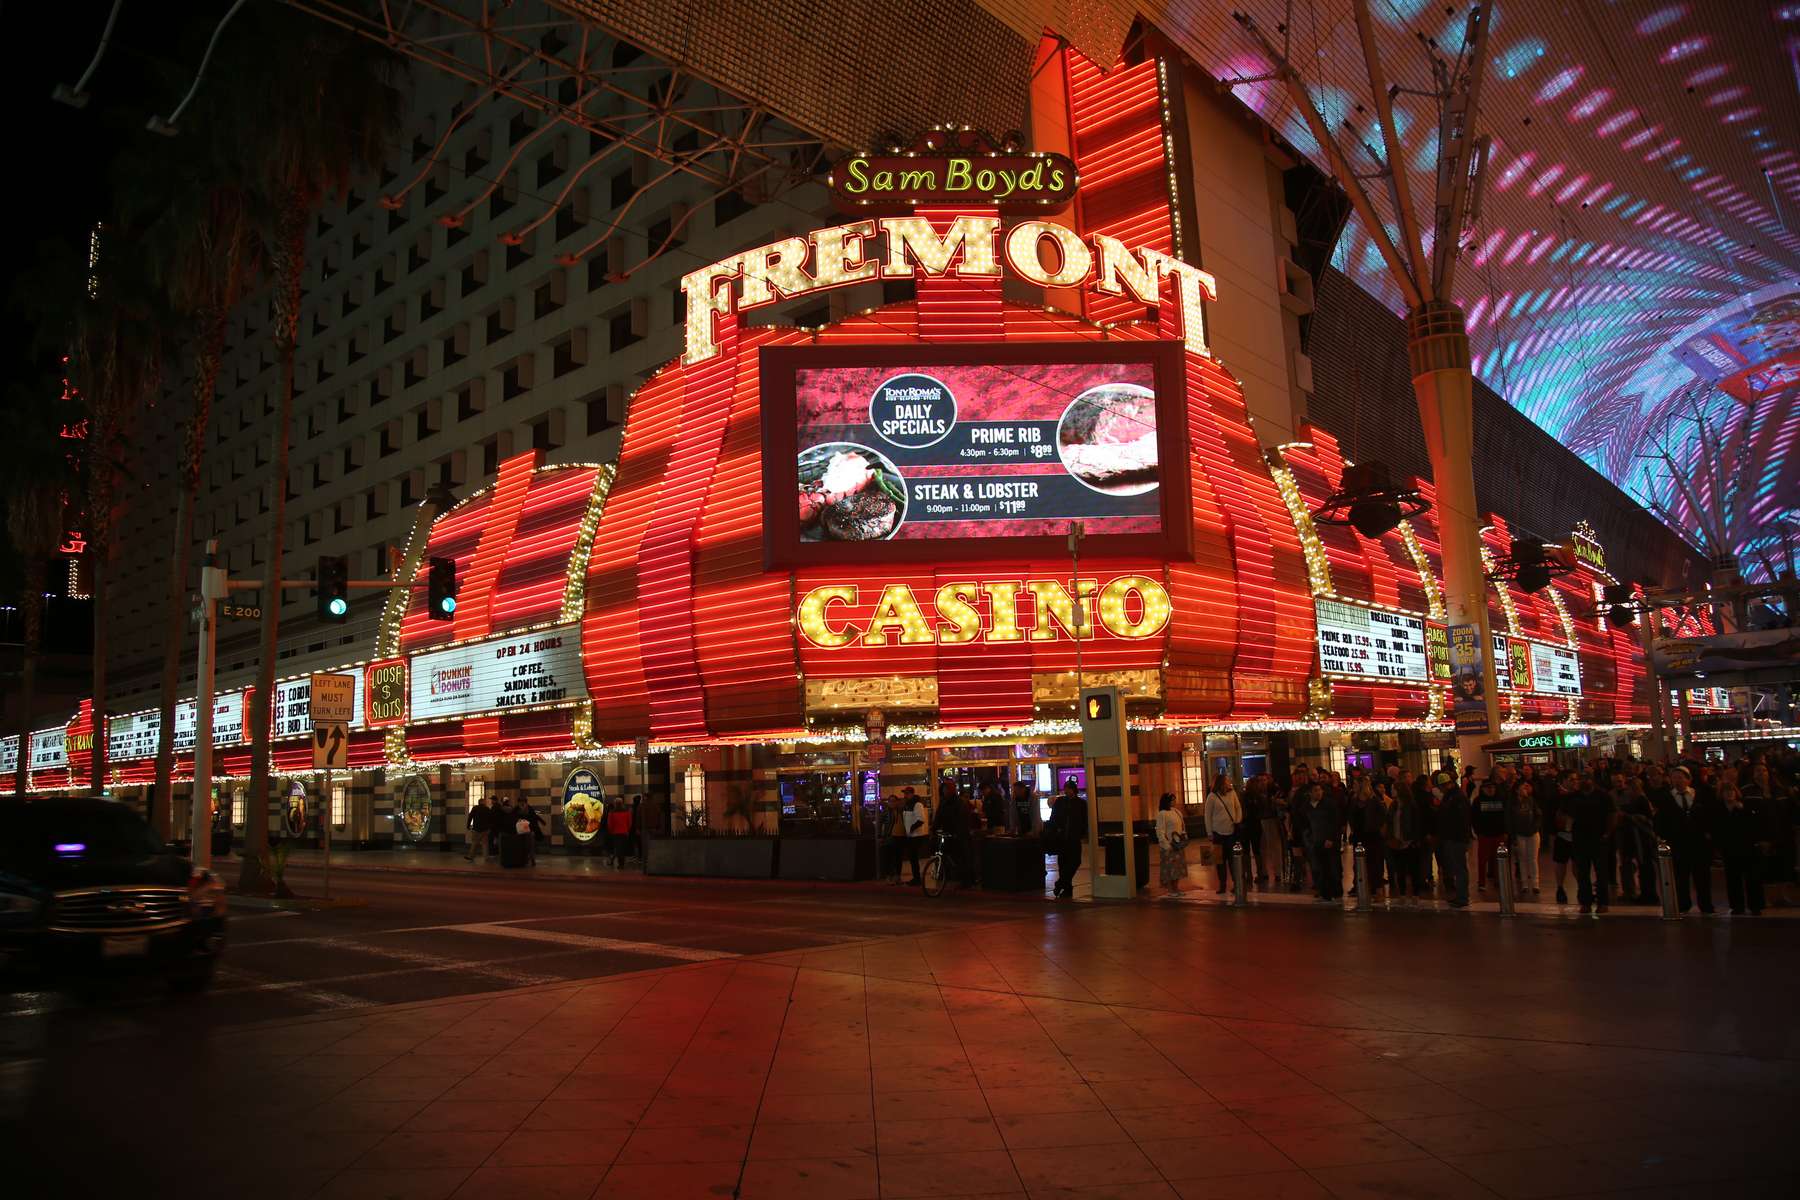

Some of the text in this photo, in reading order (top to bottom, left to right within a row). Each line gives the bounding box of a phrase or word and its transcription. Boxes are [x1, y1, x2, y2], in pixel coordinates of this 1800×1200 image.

[845, 158, 1064, 199] Sam Boyd's
[681, 216, 1217, 369] FREMONT
[884, 388, 908, 396] TONY
[896, 404, 932, 420] DAILY
[882, 419, 946, 435] SPECIALS
[971, 427, 1041, 444] PRIME RIB
[960, 448, 986, 458] 4:30pm
[993, 447, 1020, 458] 6:30pm
[914, 482, 1039, 500] STEAK & LOBSTER
[926, 504, 953, 514] 9:00pm
[961, 503, 991, 513] 11:00pm
[223, 604, 261, 618] E 200
[798, 575, 1172, 649] CASINO
[1322, 630, 1340, 643] PRIME
[1452, 628, 1472, 636] ZOOM
[1453, 634, 1474, 644] UP TO
[496, 637, 562, 660] OPEN 24 HOURS
[1322, 644, 1350, 658] SEAFOOD
[1394, 654, 1404, 664] FRI
[1456, 642, 1474, 657] 35
[442, 664, 472, 681] DUNKIN'
[512, 662, 544, 678] COFFEE,
[1324, 660, 1344, 672] STEAK
[314, 679, 351, 688] LEFT LANE
[372, 665, 402, 689] LOOSE
[288, 685, 311, 702] CORON
[382, 684, 390, 700] $
[442, 678, 471, 693] DONUTS
[321, 693, 344, 702] MUST
[496, 693, 526, 708] SNACKS
[531, 692, 537, 702] &
[312, 706, 350, 716] TURN LEFT
[372, 697, 401, 720] SLOTS
[288, 718, 300, 734] BUD
[64, 733, 94, 752] ENTRANC
[1518, 736, 1554, 748] CIGARS
